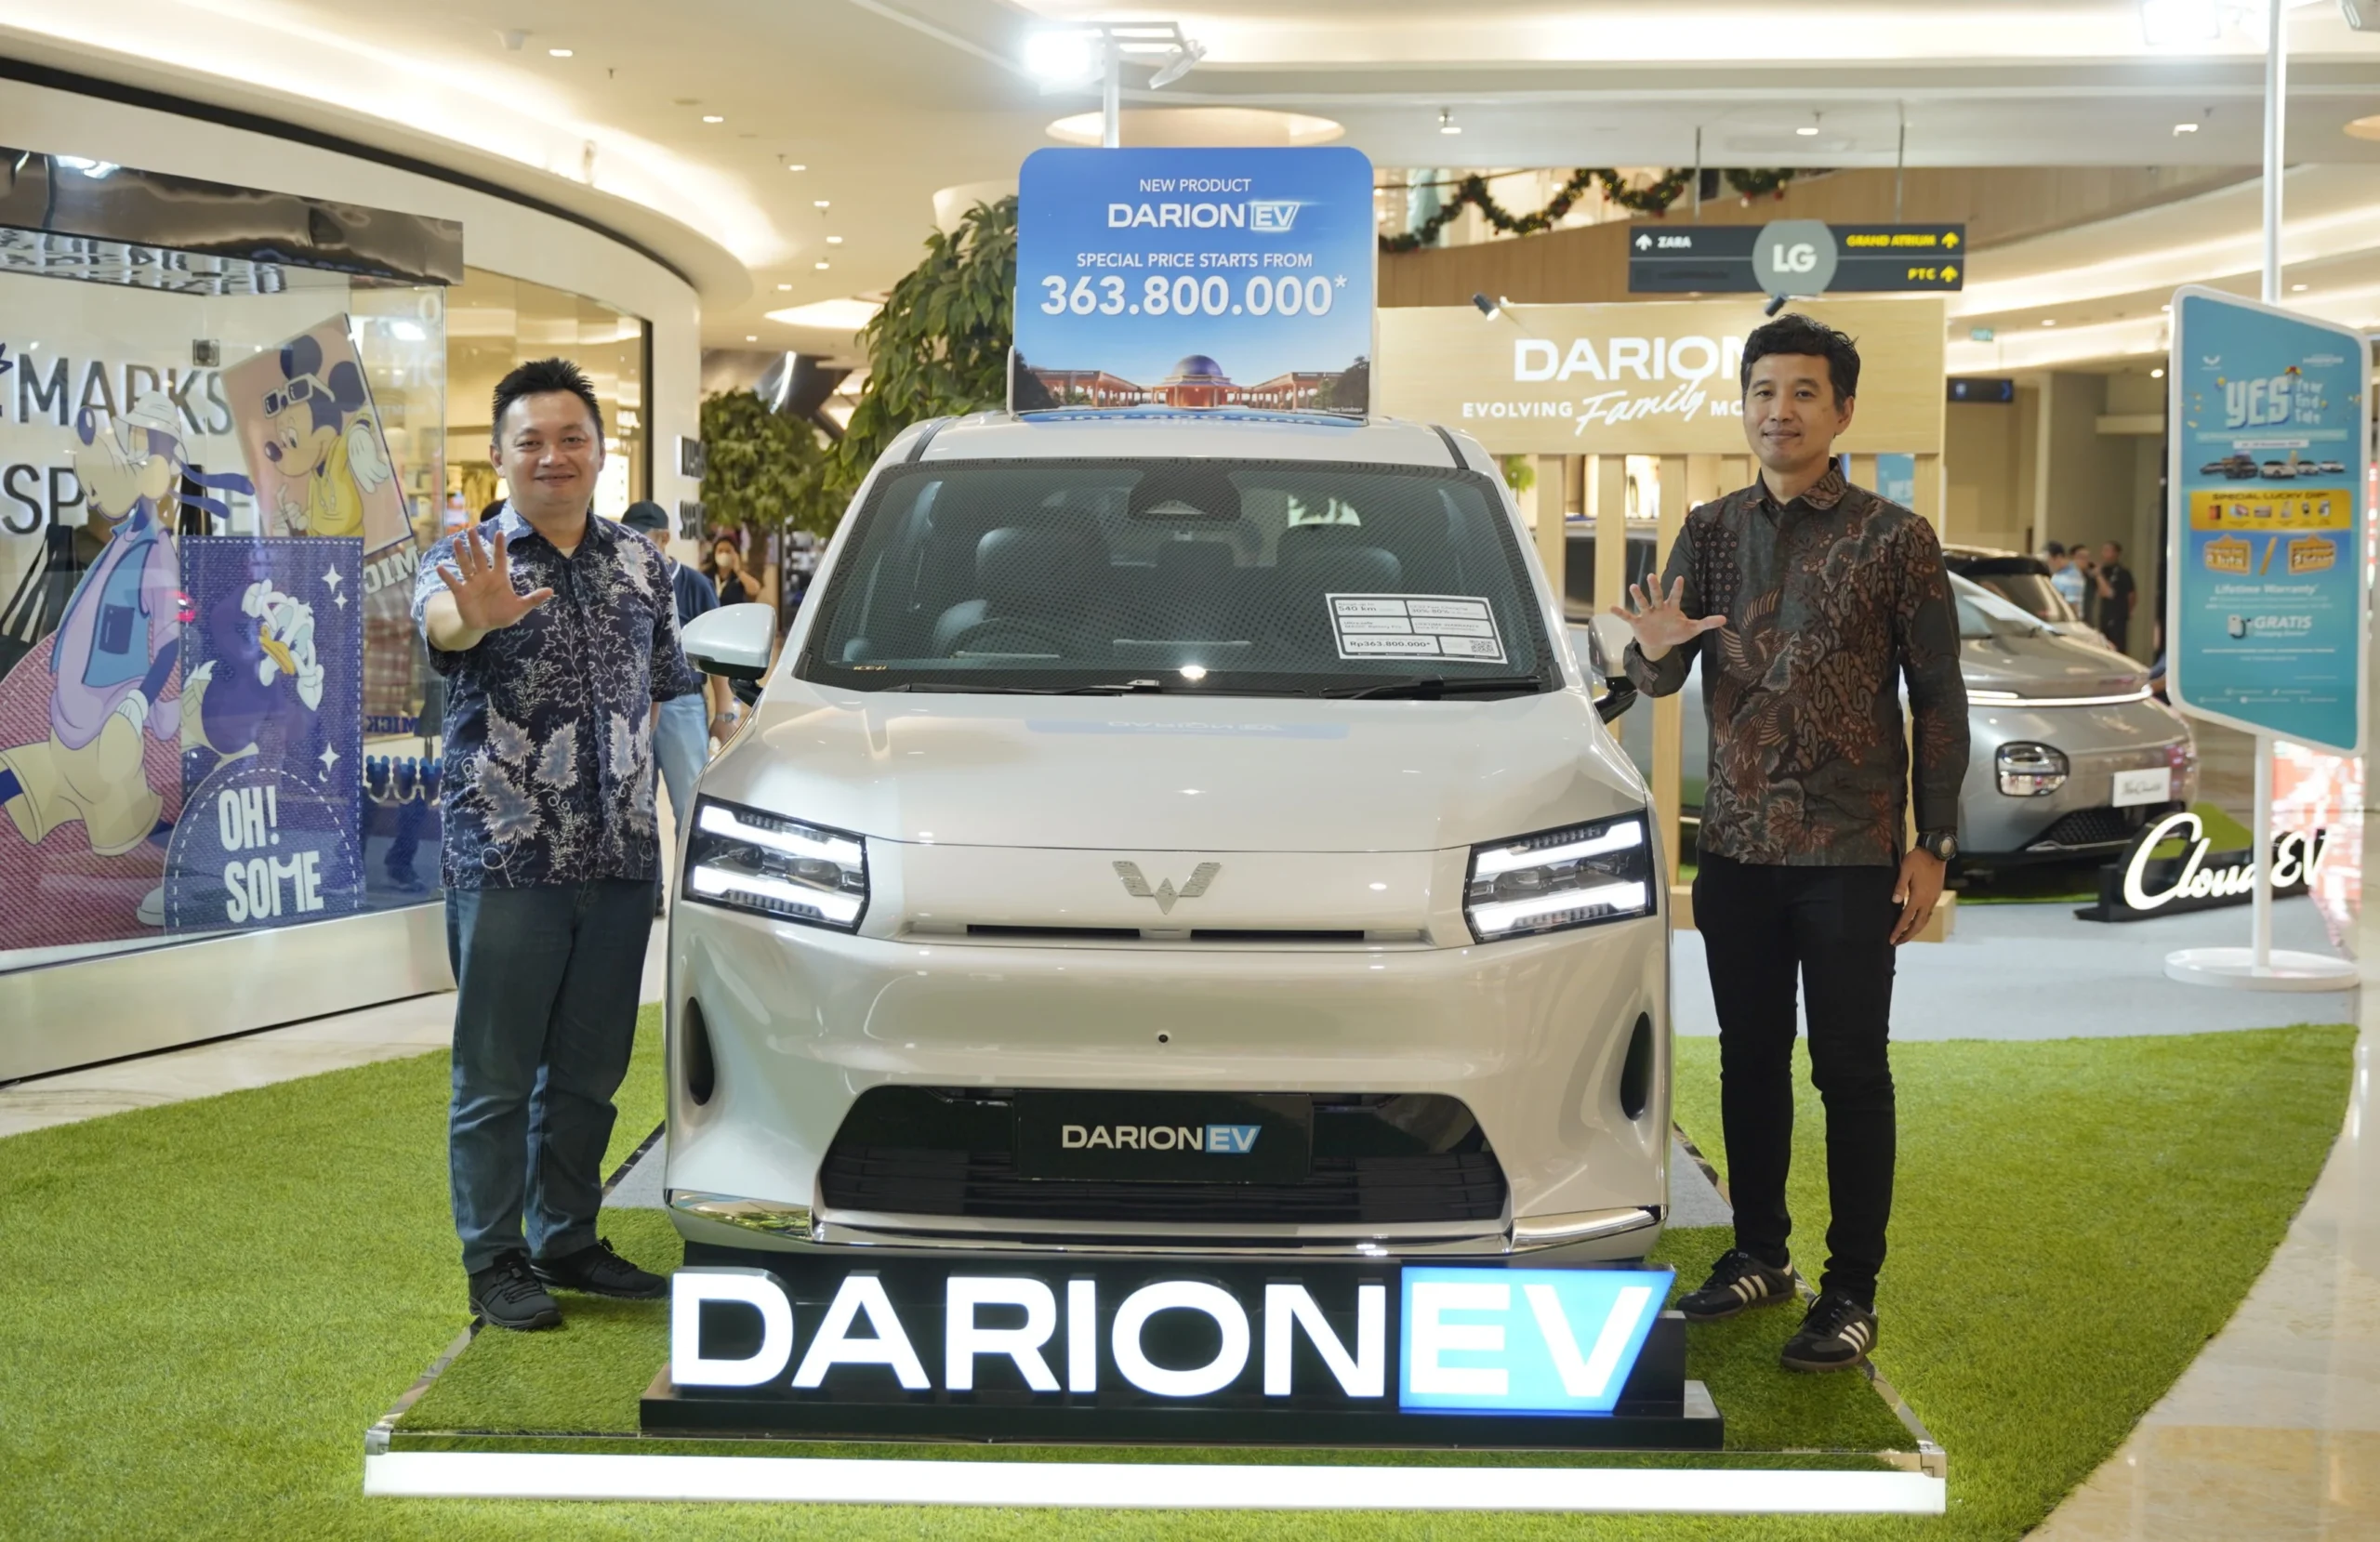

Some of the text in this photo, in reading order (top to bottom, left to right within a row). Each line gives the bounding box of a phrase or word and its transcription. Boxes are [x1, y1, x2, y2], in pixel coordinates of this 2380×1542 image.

[1139, 178, 1252, 192] NEW PRODUCT
[1107, 203, 1245, 229] DARION
[1657, 235, 1692, 248] ZARA
[1845, 233, 1937, 248] GRAND ATRIUM
[1077, 253, 1313, 268] SPECIAL PRICE STARTS FROM
[1772, 244, 1817, 273] LG
[1907, 268, 1937, 281] PTC
[1462, 401, 1573, 418] EVOLVING
[1574, 376, 1707, 437] Family
[2254, 614, 2312, 629] GRATIS
[218, 784, 279, 852] OH!
[224, 850, 324, 923] SOME
